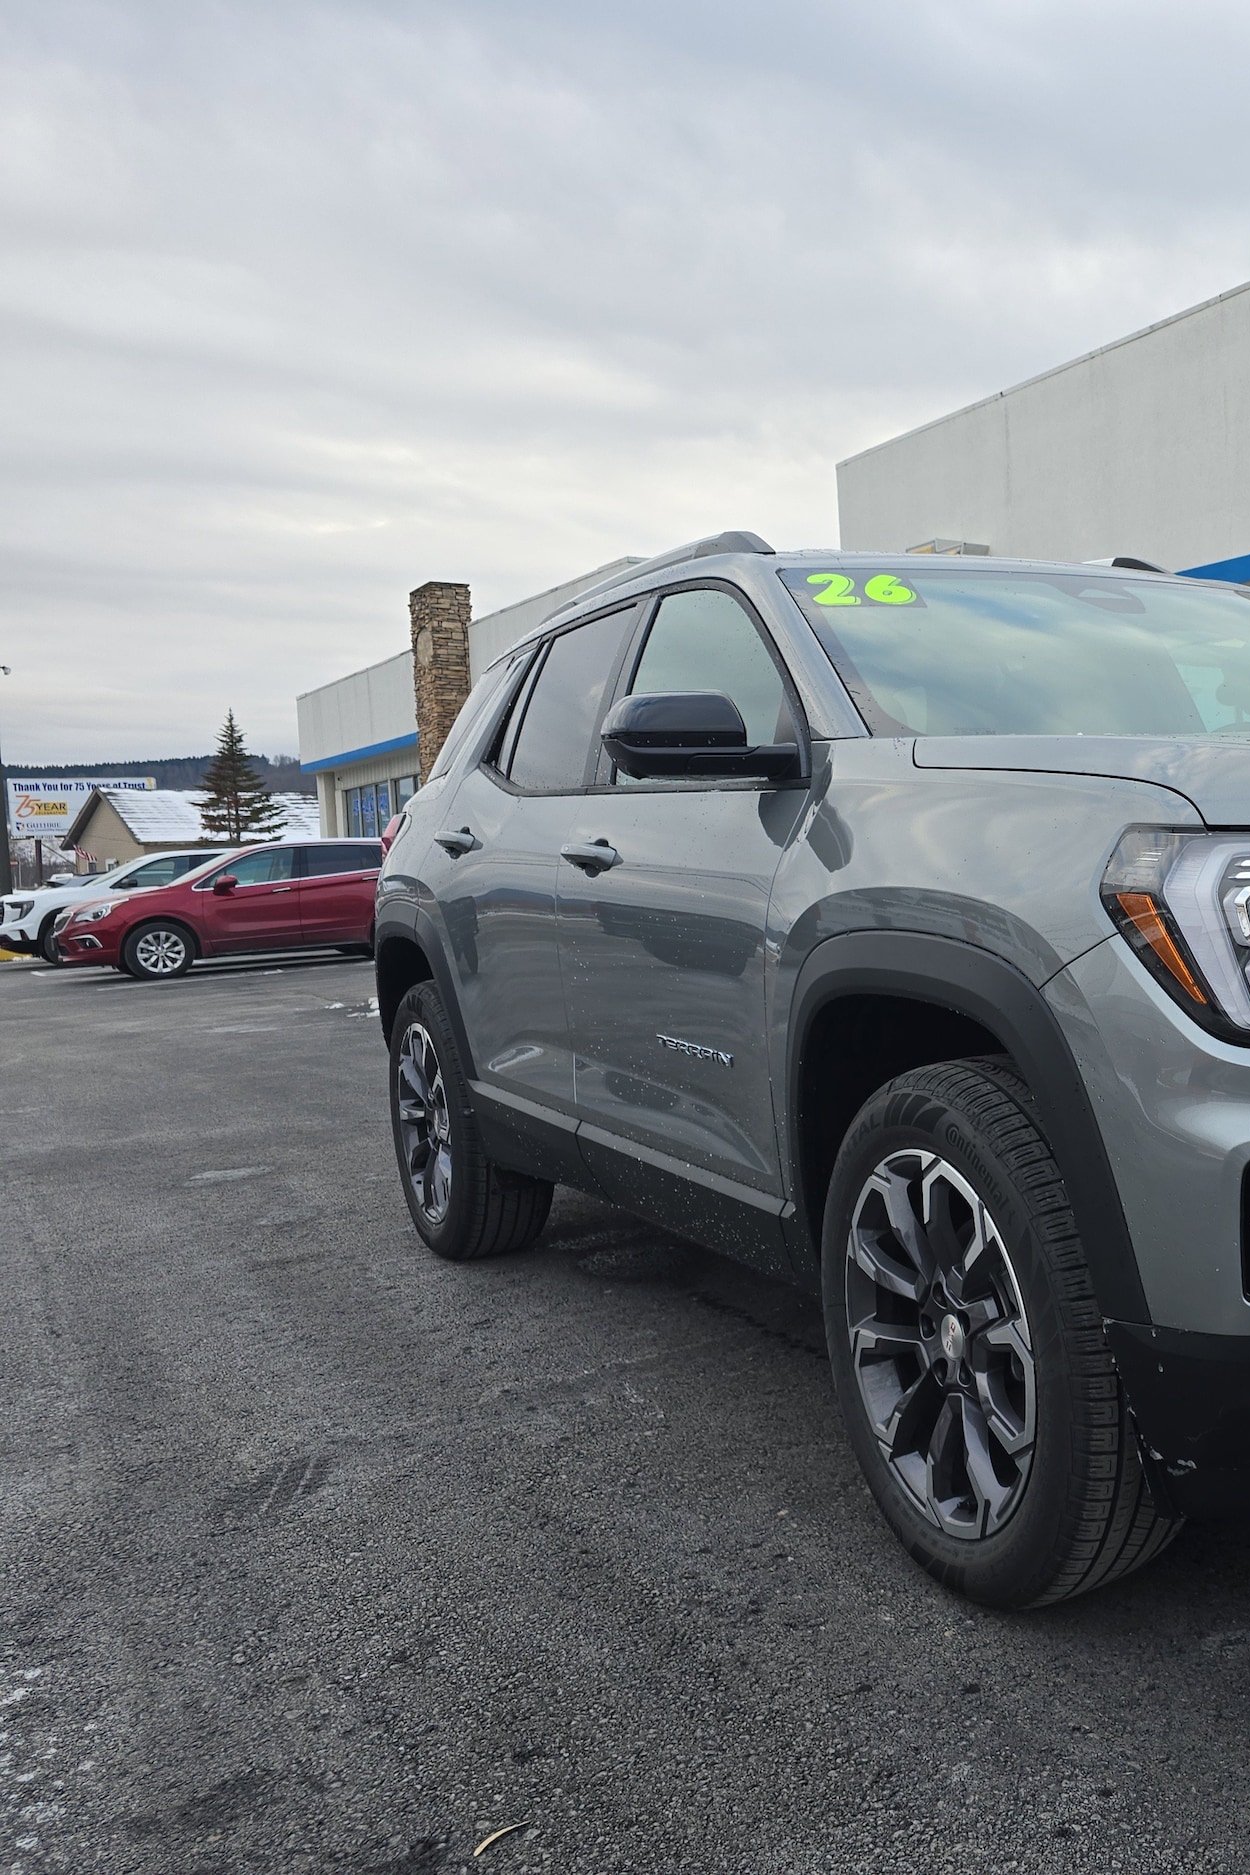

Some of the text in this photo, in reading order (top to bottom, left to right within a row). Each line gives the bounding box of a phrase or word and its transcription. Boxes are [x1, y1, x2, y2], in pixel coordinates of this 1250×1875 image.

[806, 573, 917, 606] 26
[13, 782, 41, 792] Thank
[42, 782, 58, 792] You
[60, 782, 73, 791] for
[74, 782, 85, 791] 75
[123, 782, 145, 790] Trust
[15, 795, 66, 818] 75 YEAR
[656, 1033, 734, 1067] TERRAIN
[945, 1123, 1010, 1210] Continental
